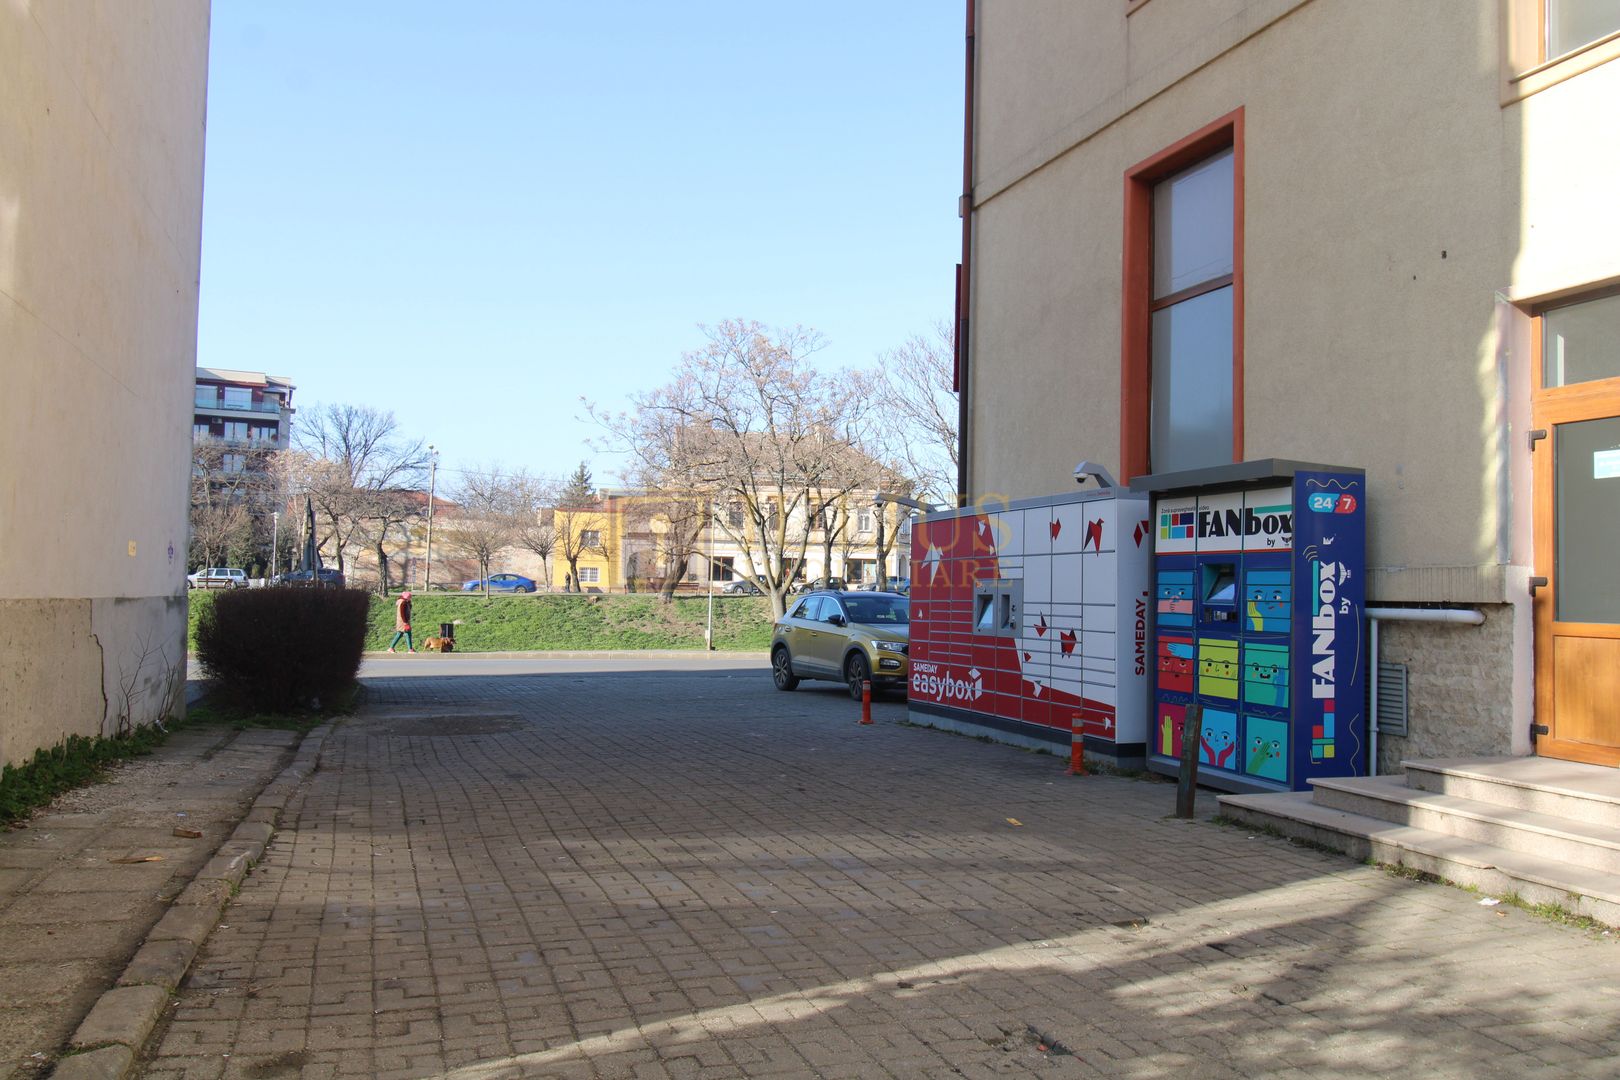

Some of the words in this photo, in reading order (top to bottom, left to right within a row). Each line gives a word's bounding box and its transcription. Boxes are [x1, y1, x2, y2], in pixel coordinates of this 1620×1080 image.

[1313, 496, 1333, 509] 24
[1342, 498, 1352, 510] 7
[1198, 507, 1293, 538] FANbox
[1266, 537, 1276, 547] by
[1339, 597, 1351, 615] by
[1135, 598, 1146, 676] SAMEDAY
[1312, 560, 1336, 699] FANbox
[913, 662, 938, 674] SAMEDAY
[912, 670, 974, 702] easybox
